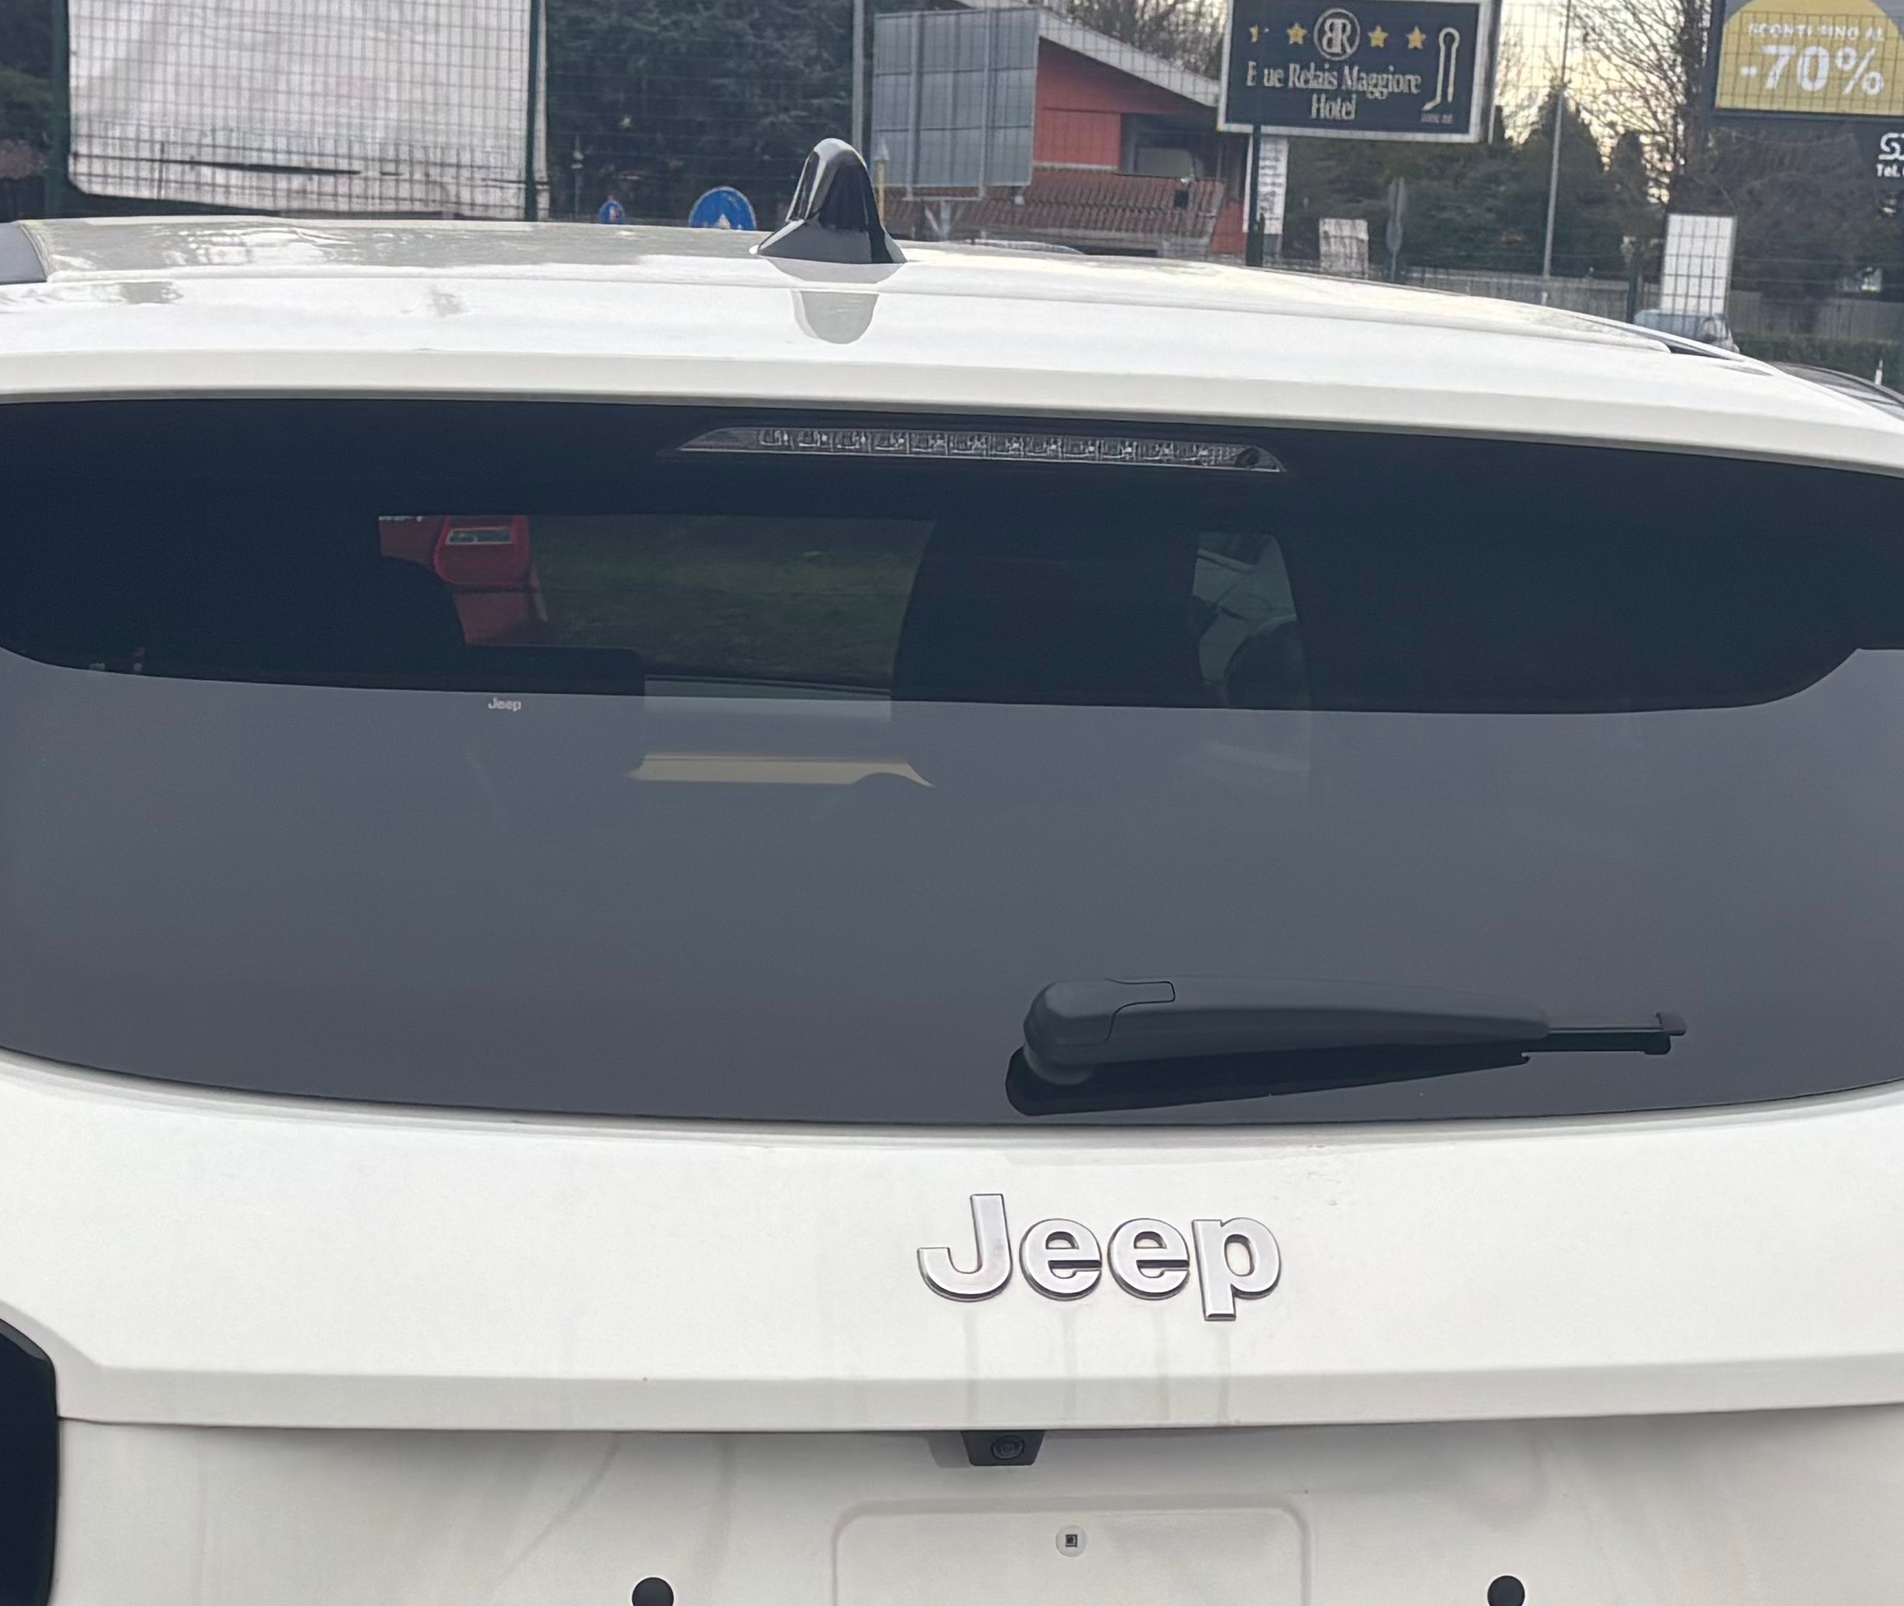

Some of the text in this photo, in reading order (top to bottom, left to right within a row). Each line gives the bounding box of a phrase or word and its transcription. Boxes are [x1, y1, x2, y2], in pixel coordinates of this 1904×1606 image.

[1289, 62, 1338, 90] Relais
[1342, 65, 1421, 99] Maggiore
[1740, 44, 1885, 95] -70%
[1310, 94, 1356, 120] Hotel
[487, 697, 522, 712] Jeep
[917, 1193, 1281, 1321] Jeep
